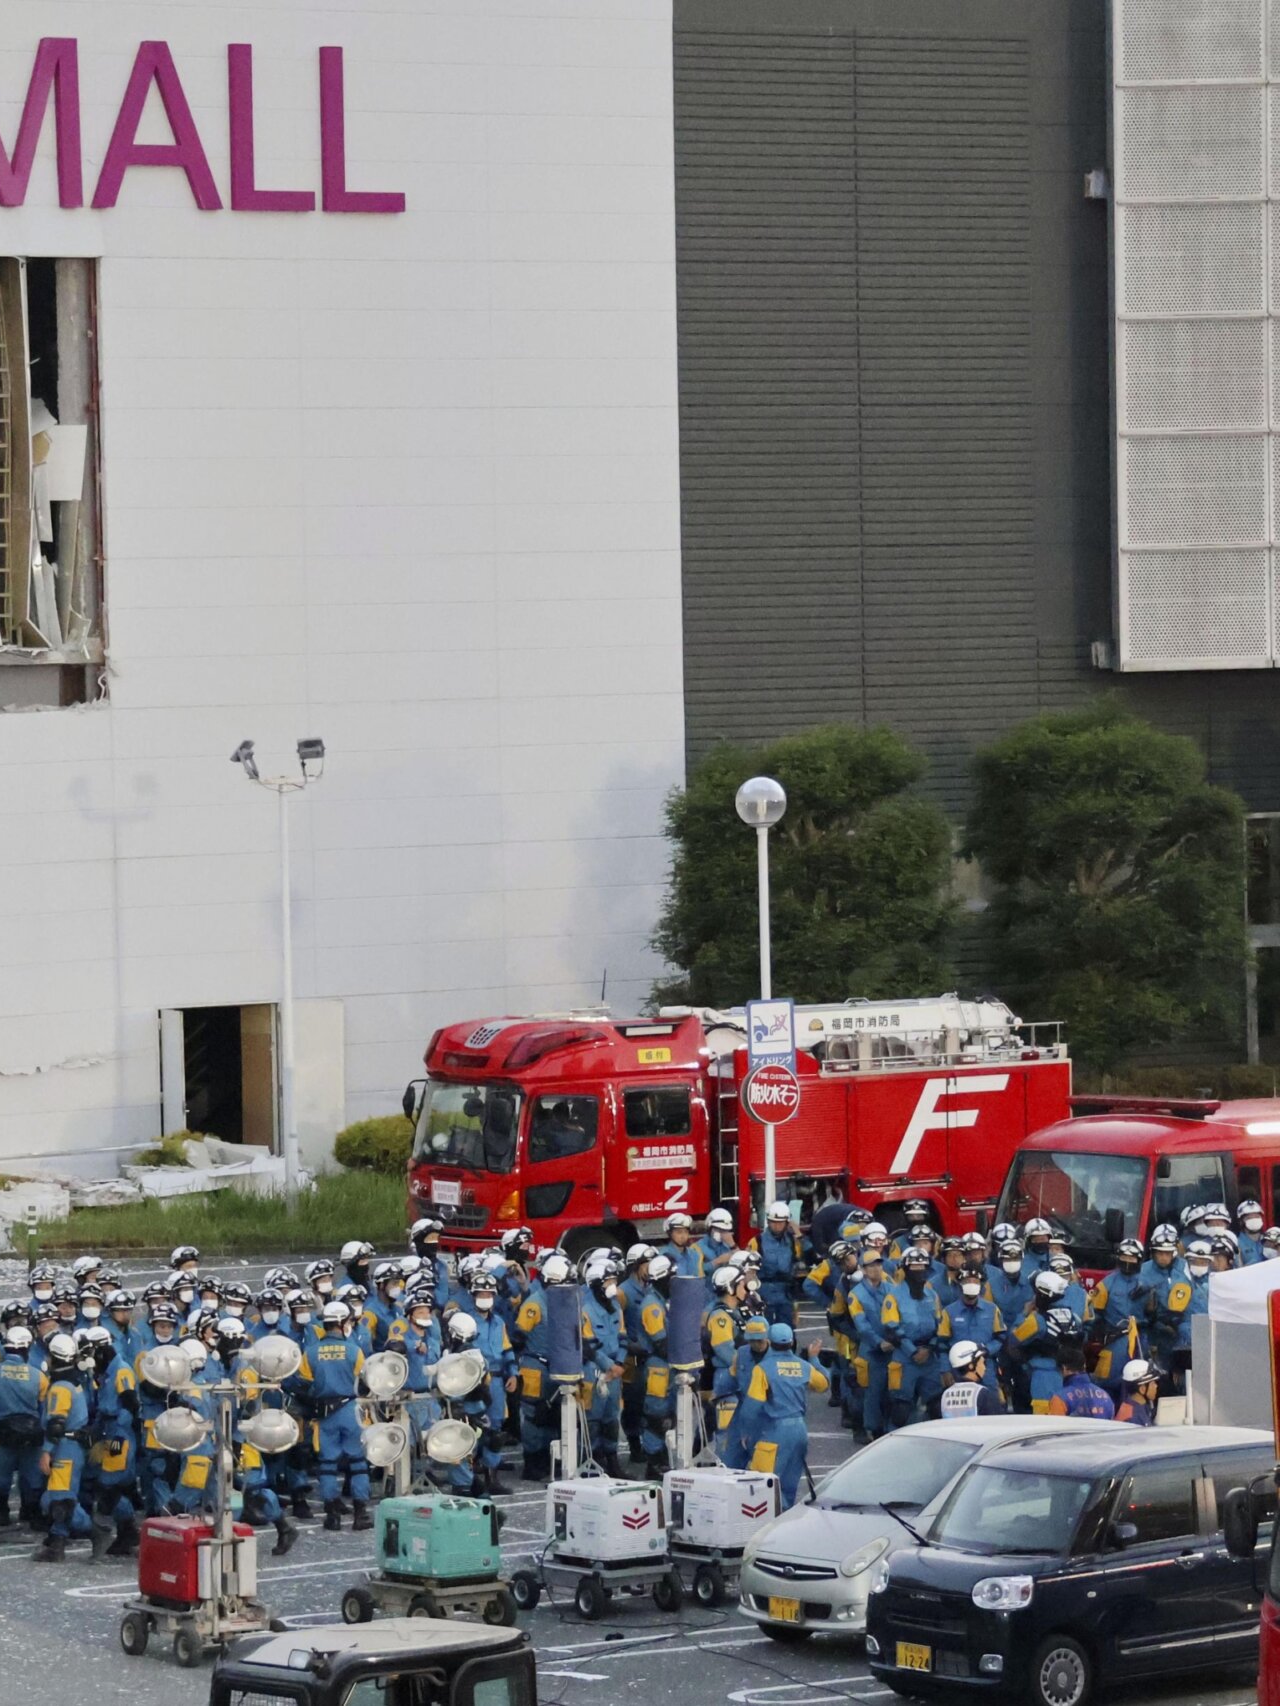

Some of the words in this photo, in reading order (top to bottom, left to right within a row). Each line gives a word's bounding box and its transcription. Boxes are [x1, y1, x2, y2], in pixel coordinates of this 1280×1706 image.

[831, 1014, 900, 1031] 福岡市消防局
[751, 1055, 793, 1068] アイドリング
[750, 1083, 798, 1107] 防火水そう
[888, 1073, 1010, 1175] F
[664, 1178, 689, 1211] 2
[318, 1352, 346, 1361] POLICE
[1, 1371, 30, 1381] POLICE
[778, 1368, 802, 1378] POLICE
